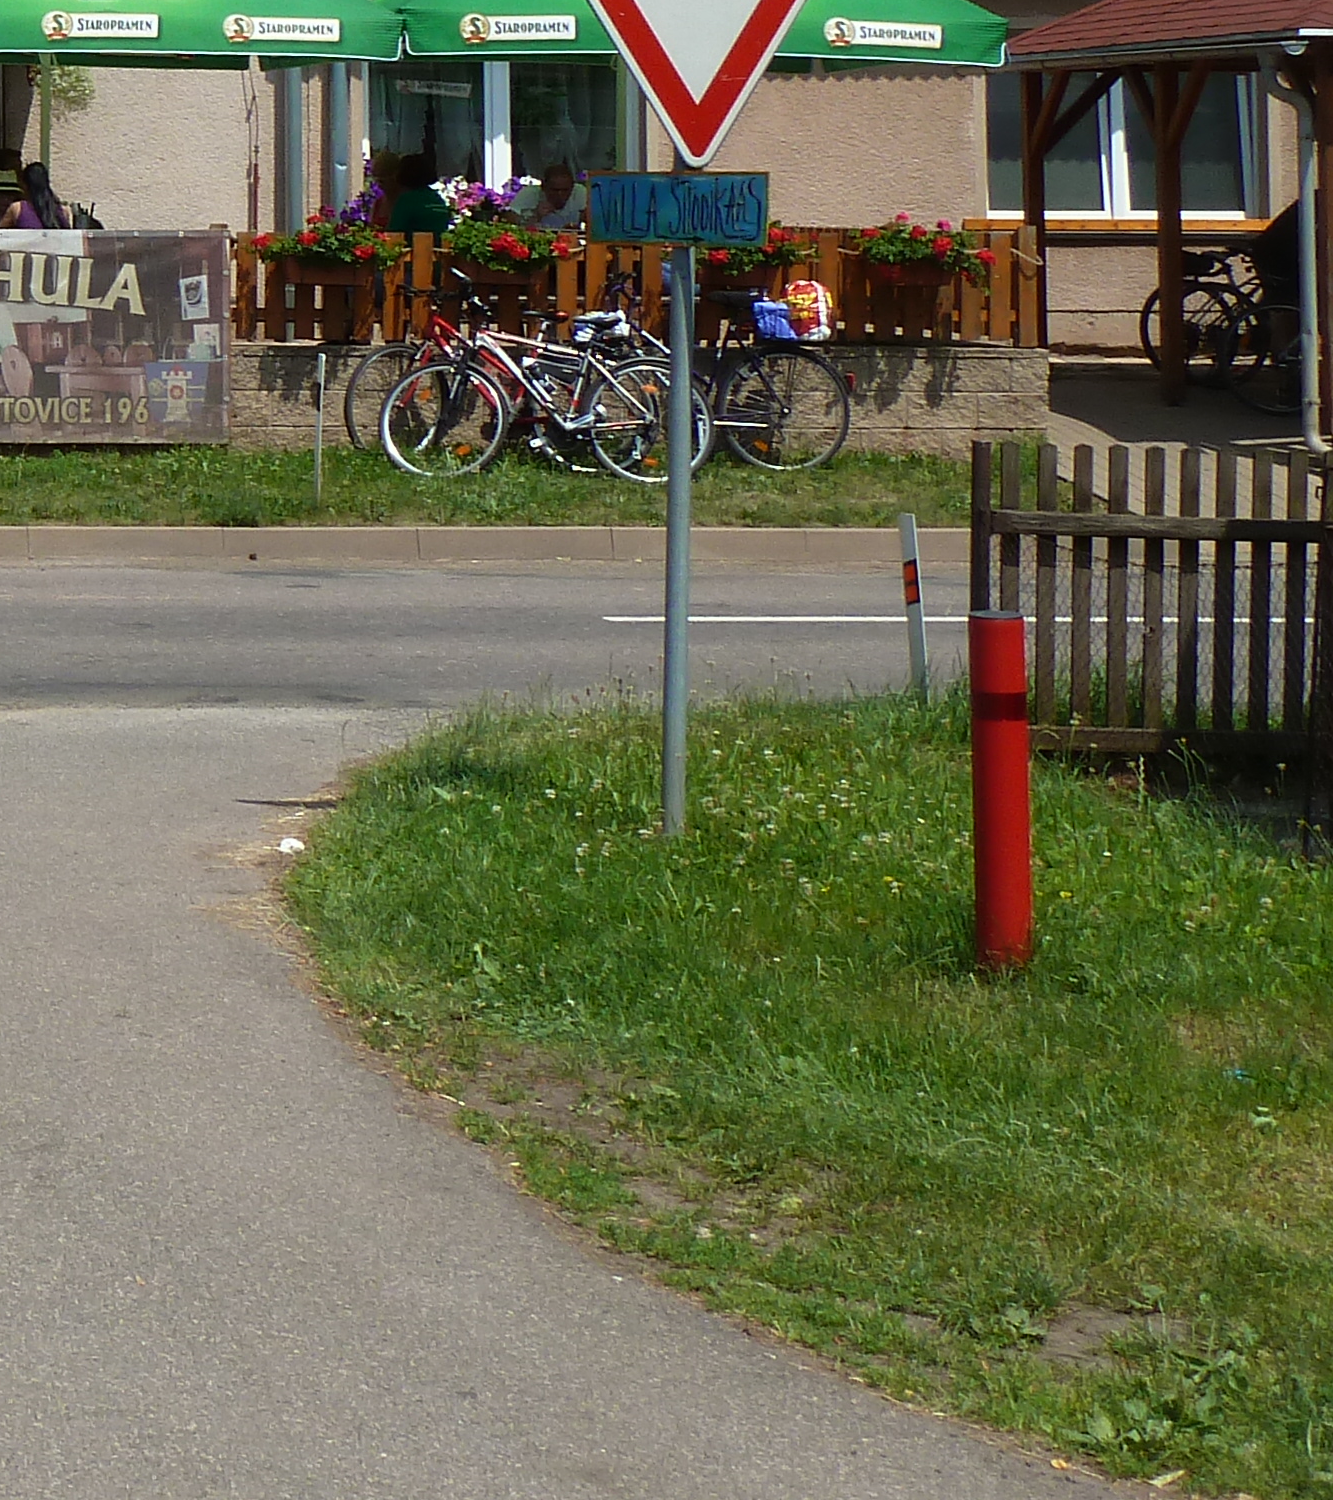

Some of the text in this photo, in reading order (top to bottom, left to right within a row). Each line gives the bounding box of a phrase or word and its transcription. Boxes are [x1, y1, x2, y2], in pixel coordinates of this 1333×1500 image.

[76, 17, 153, 32] STAROPRAMEN
[258, 21, 333, 37] STAROPRAMEN
[494, 20, 570, 35] STAROPRAMEN
[859, 25, 935, 41] STAROPRAMEN
[102, 397, 149, 424] 196
